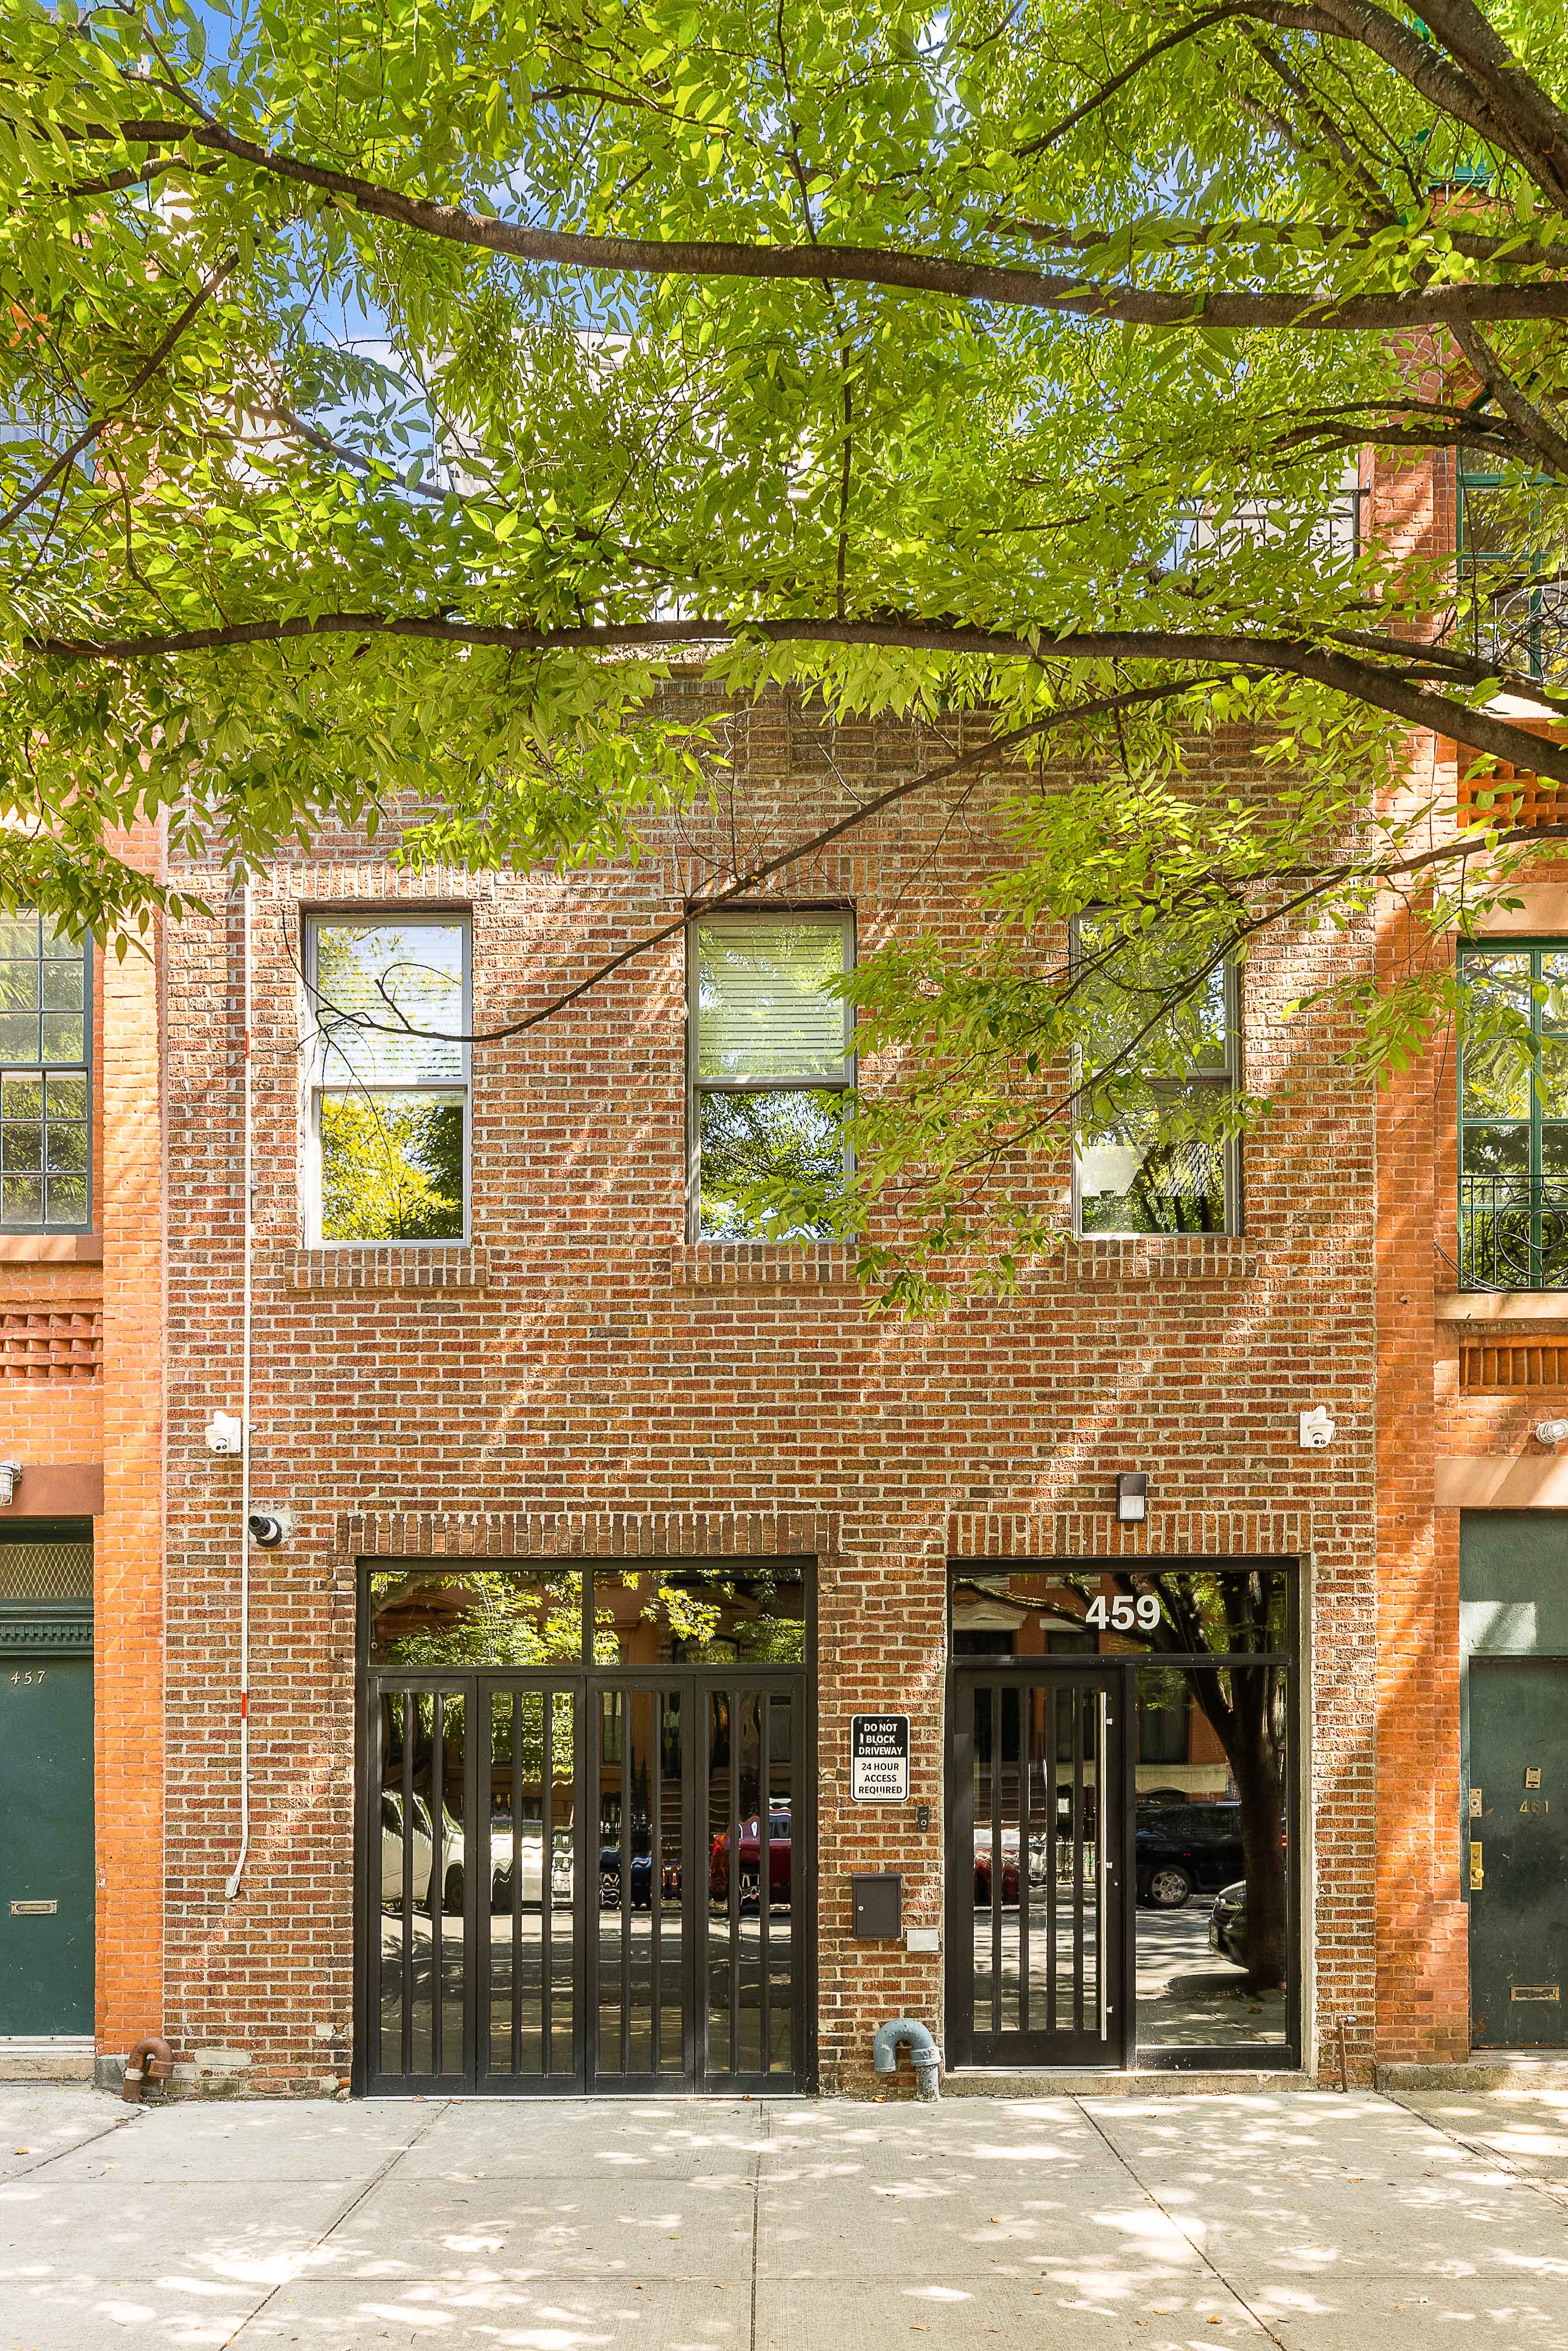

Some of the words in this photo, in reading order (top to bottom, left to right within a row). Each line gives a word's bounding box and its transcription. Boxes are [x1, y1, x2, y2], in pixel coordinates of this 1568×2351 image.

[1157, 1212, 1167, 1223] hp
[1085, 1595, 1160, 1630] 459
[11, 1671, 47, 1685] 457
[864, 1723, 877, 1732] DO
[879, 1723, 898, 1732] NOT
[866, 1735, 895, 1743] BLOCK
[859, 1747, 903, 1755] DRIVEWAY
[859, 1786, 902, 1794] REQUIRED
